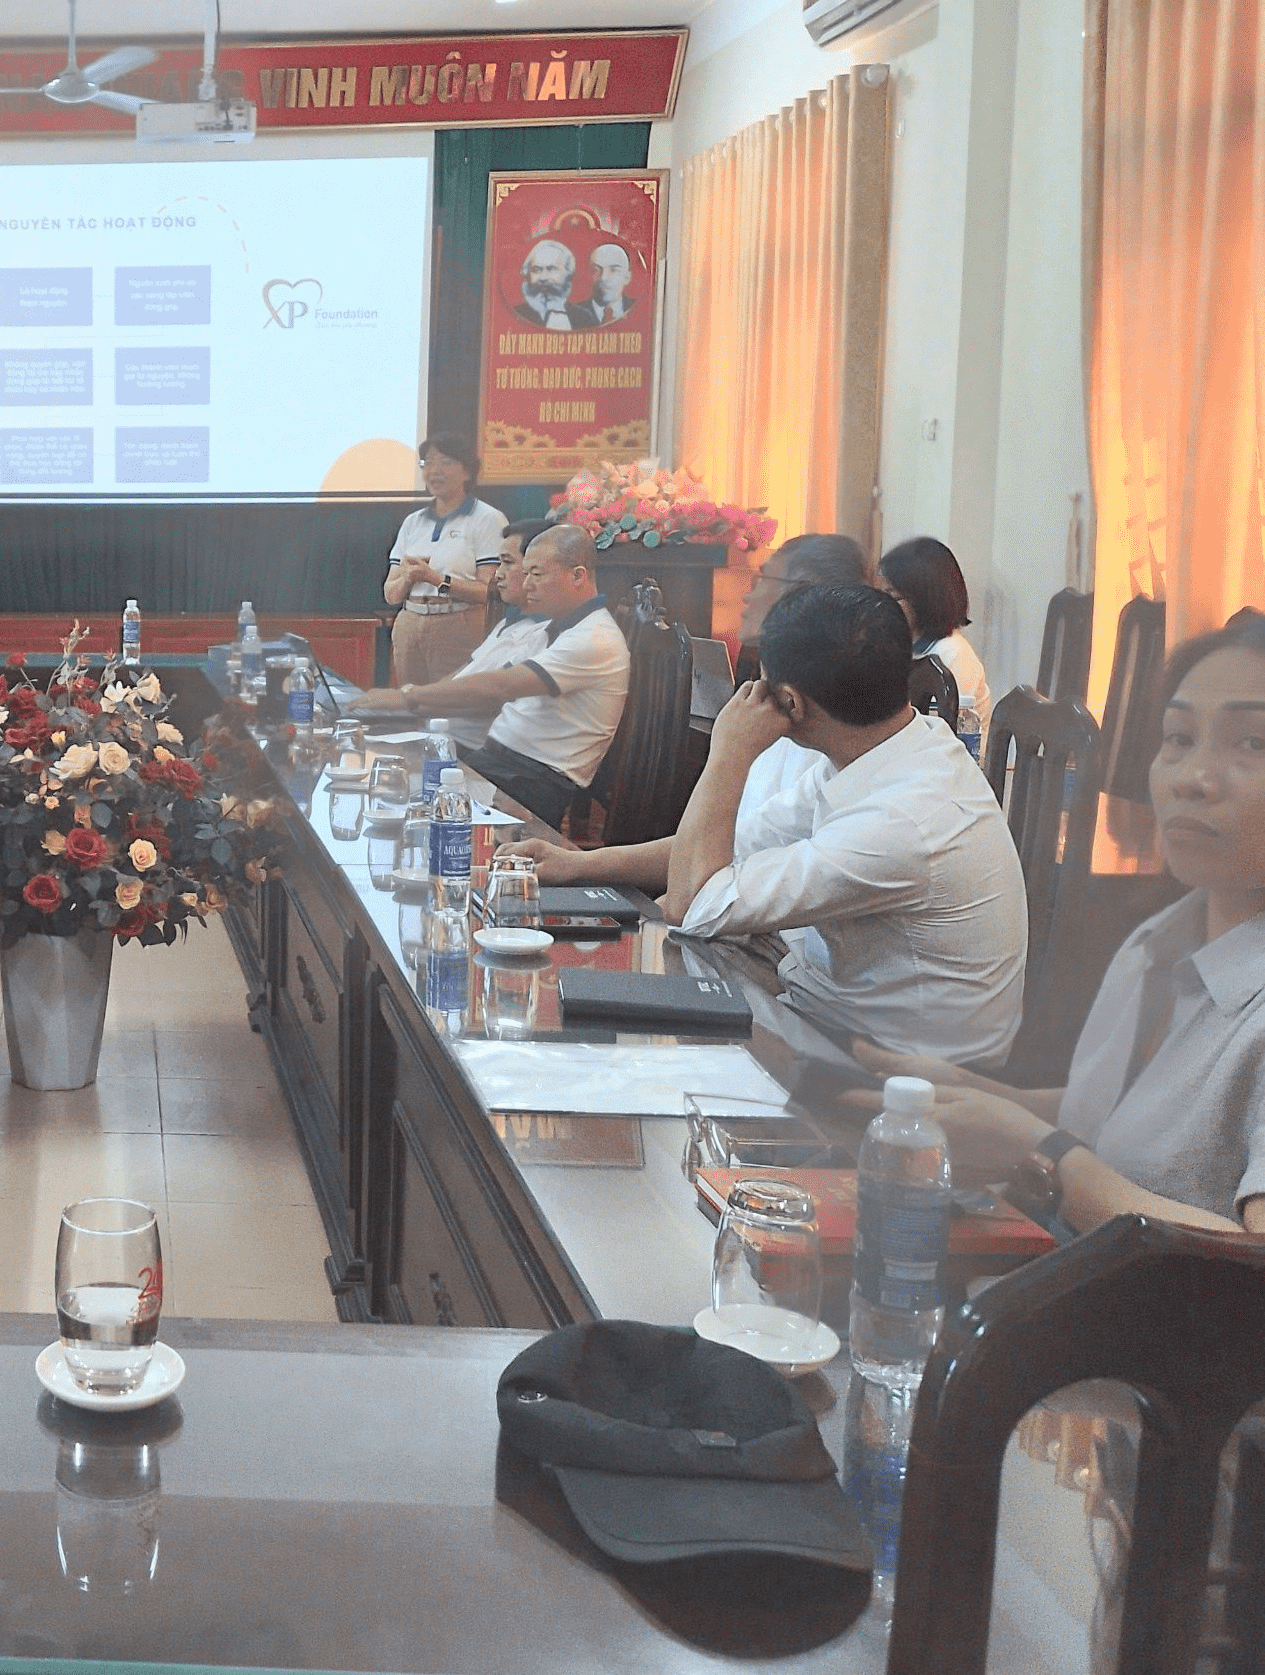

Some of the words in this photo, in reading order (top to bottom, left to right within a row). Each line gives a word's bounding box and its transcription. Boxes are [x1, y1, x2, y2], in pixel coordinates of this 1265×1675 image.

[260, 65, 357, 109] VINH
[370, 52, 495, 105] MUÔN
[506, 49, 612, 102] NĂM
[314, 307, 378, 319] Foundation
[619, 332, 642, 354] THEO
[585, 367, 616, 389] PHONG
[571, 401, 596, 422] MINH
